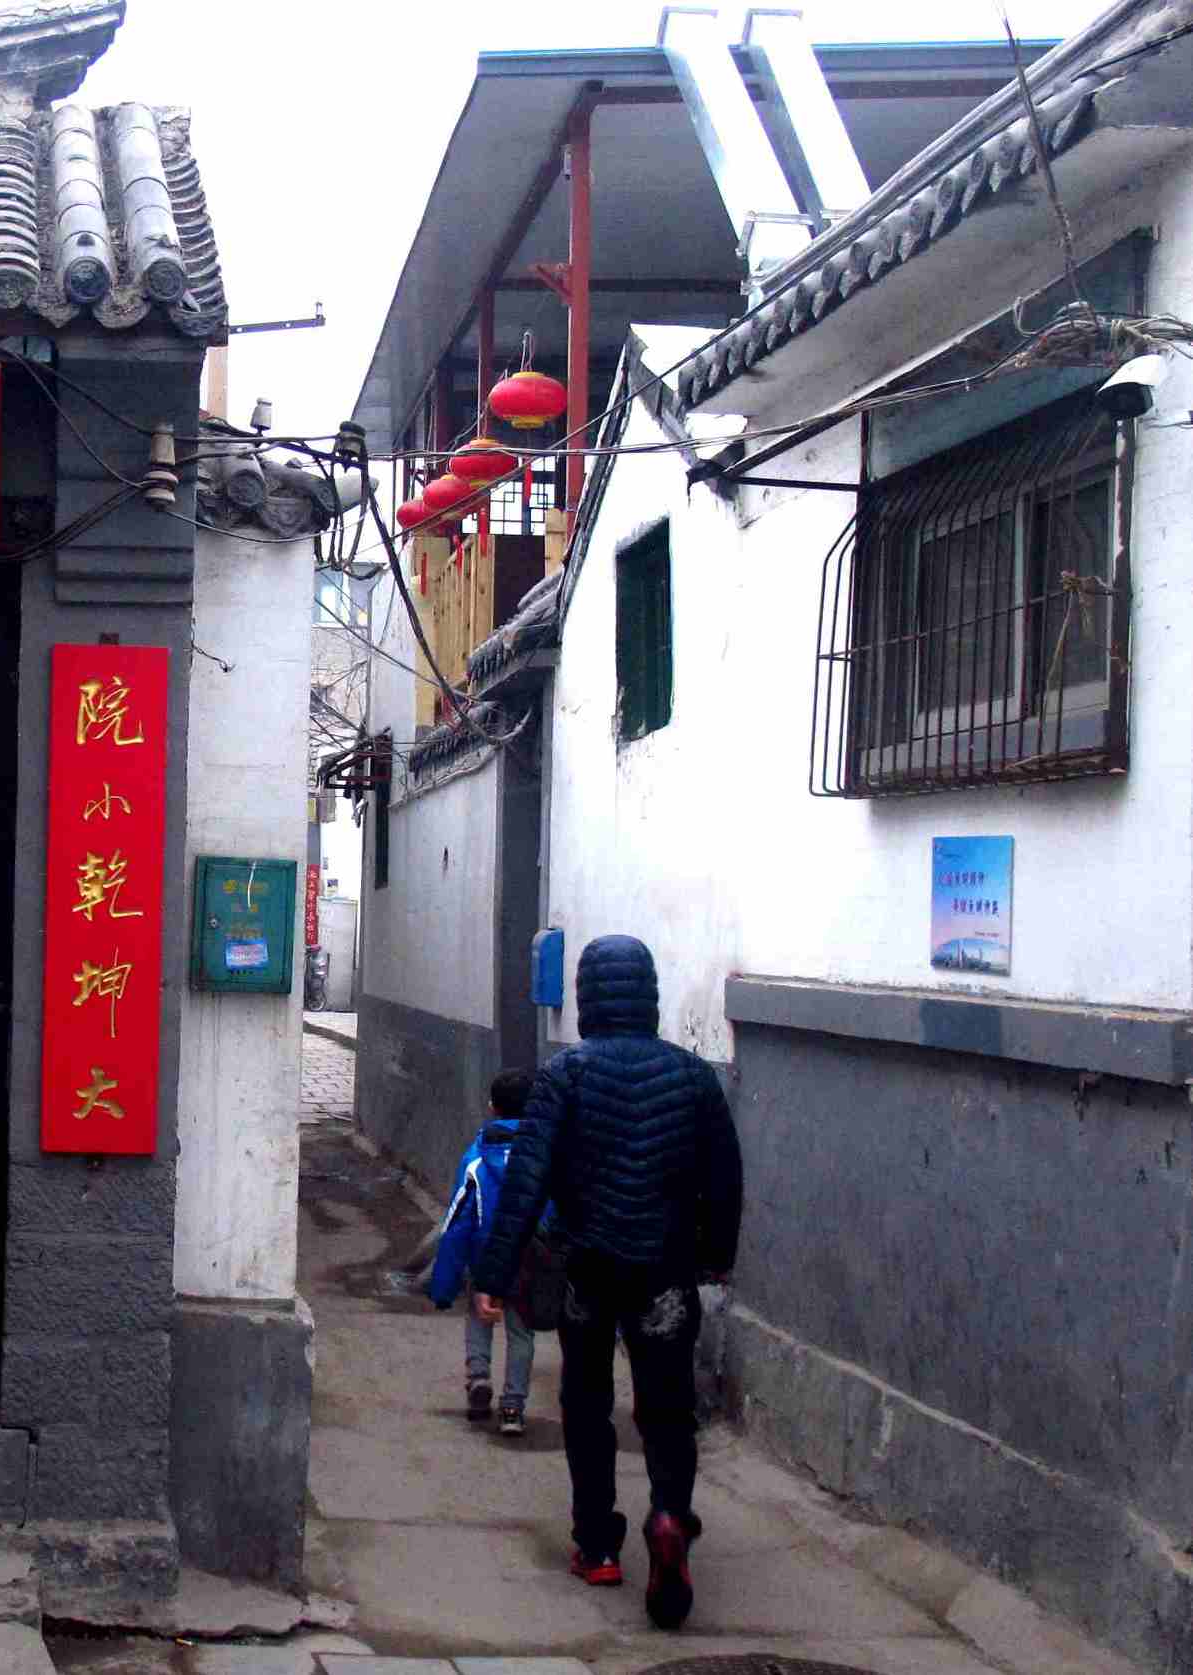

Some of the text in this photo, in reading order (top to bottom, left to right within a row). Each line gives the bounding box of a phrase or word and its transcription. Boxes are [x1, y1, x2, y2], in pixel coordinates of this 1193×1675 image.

[72, 675, 145, 1120] 院小乾坤大
